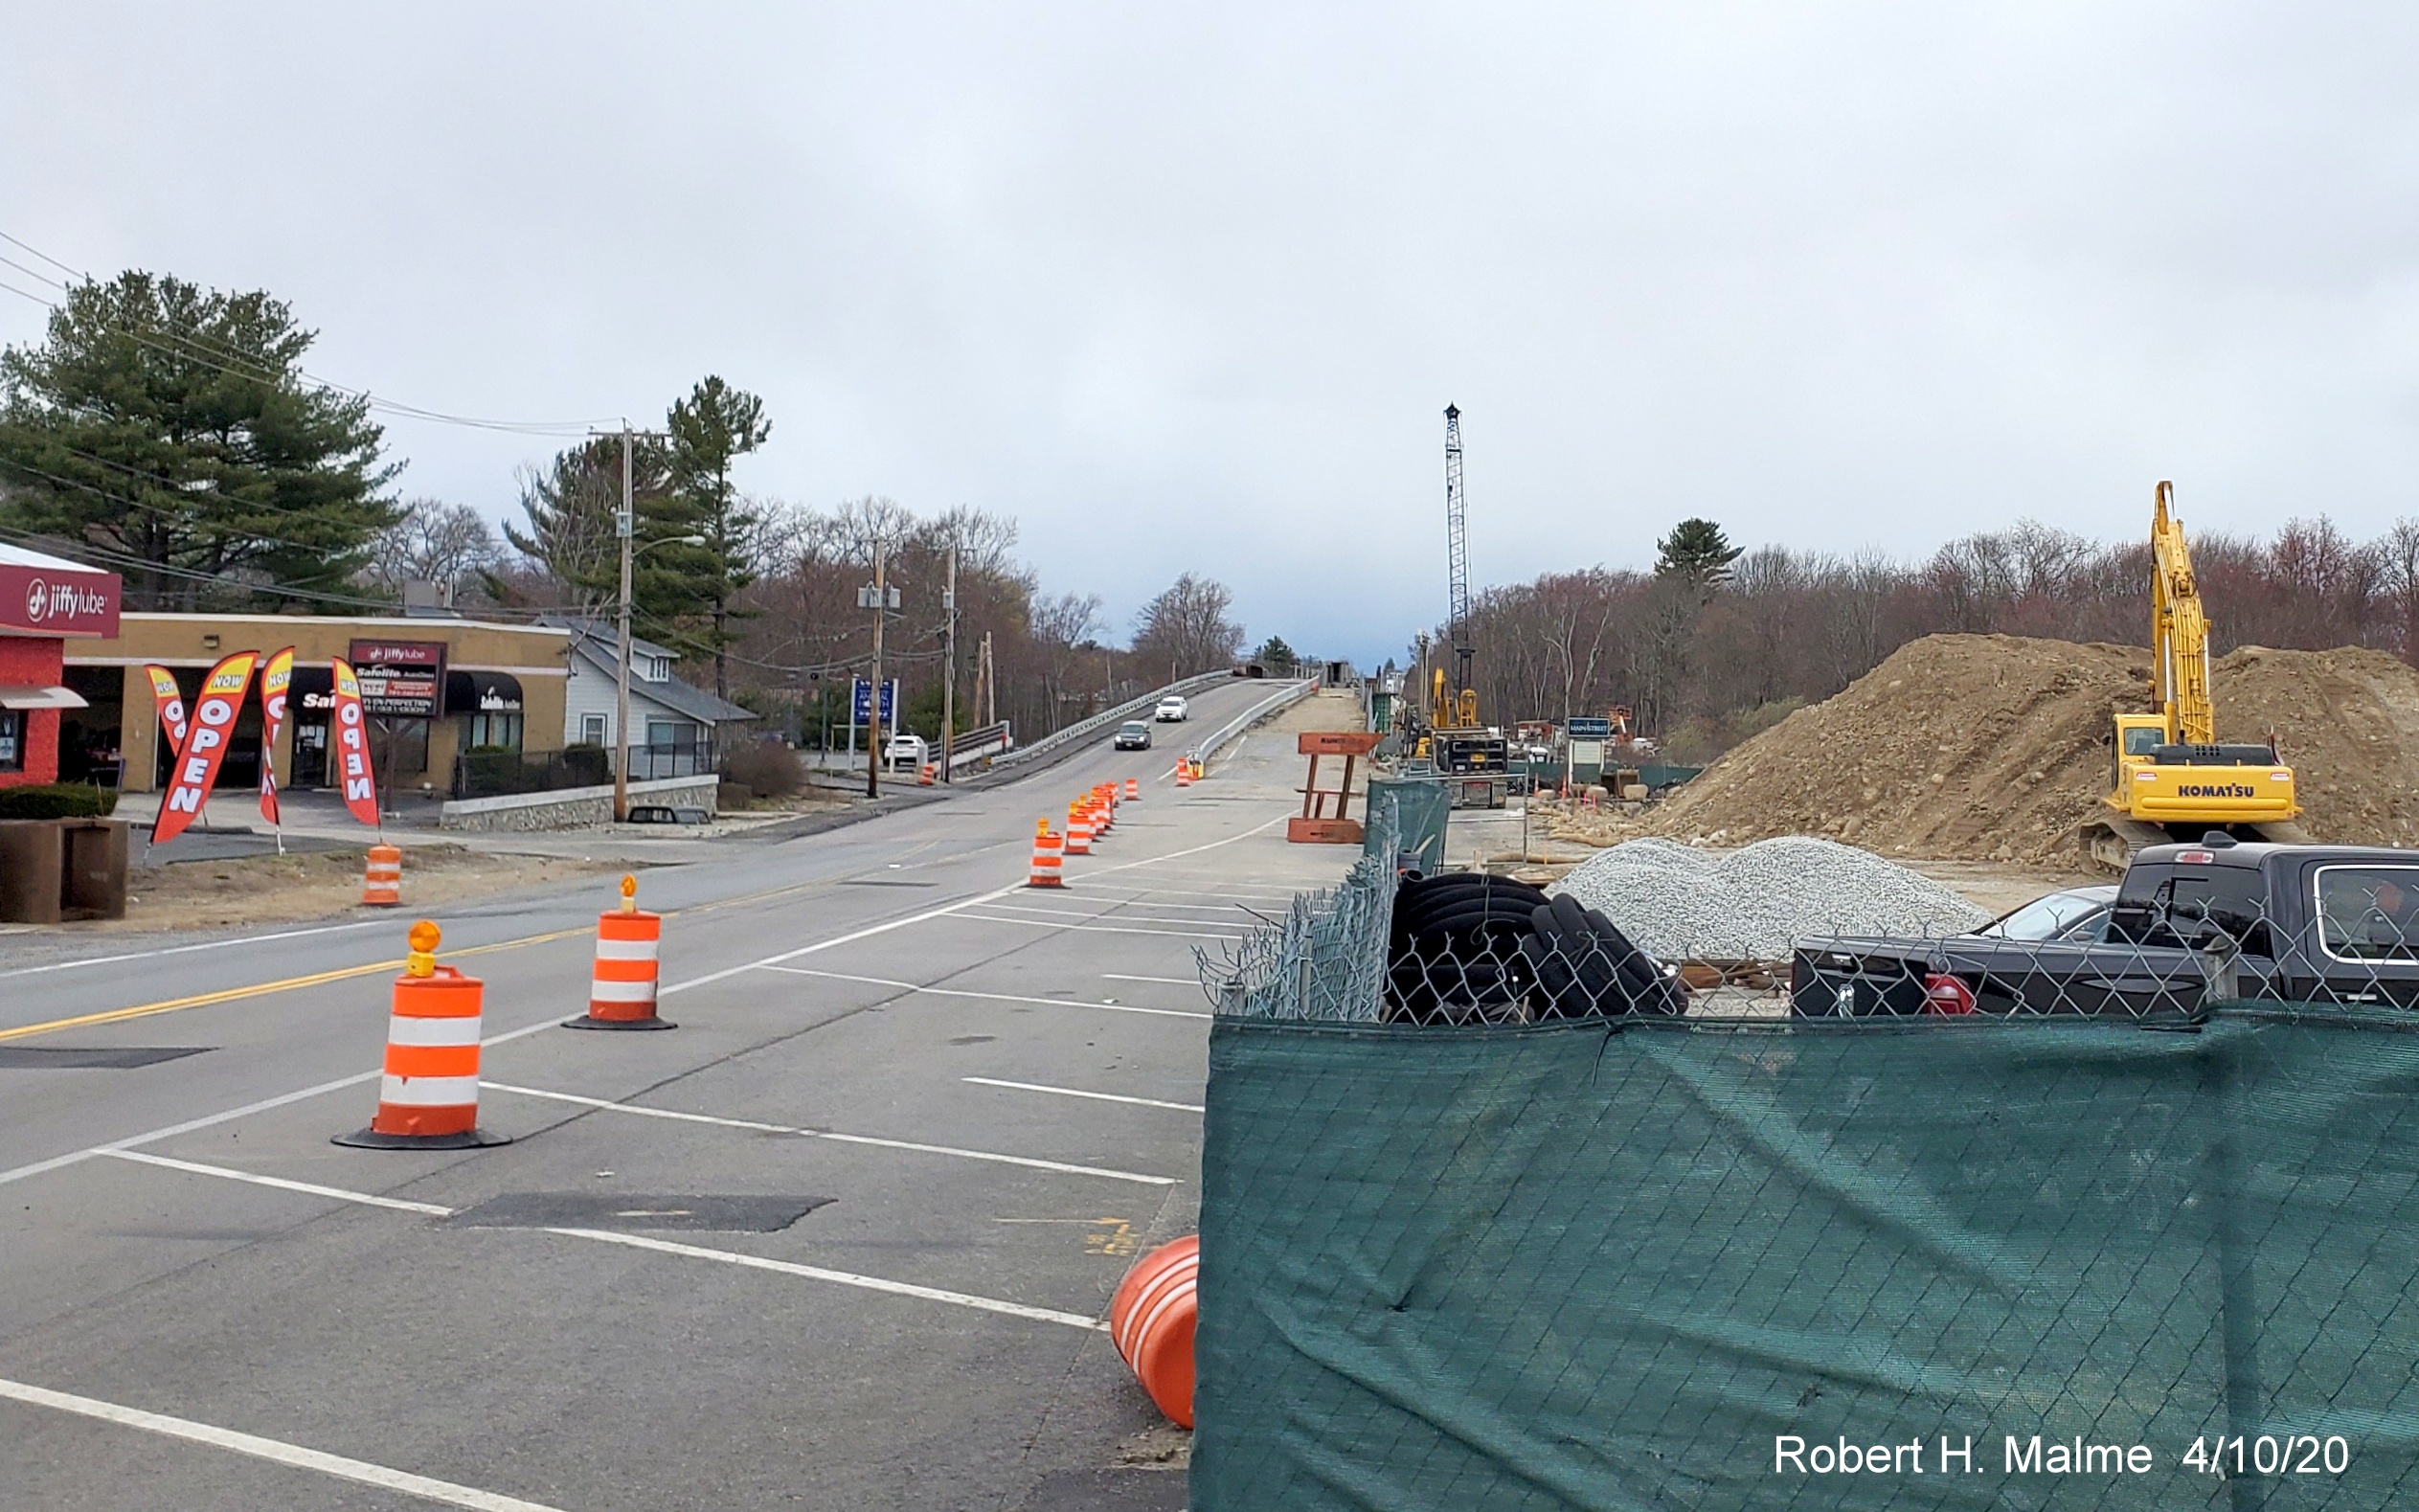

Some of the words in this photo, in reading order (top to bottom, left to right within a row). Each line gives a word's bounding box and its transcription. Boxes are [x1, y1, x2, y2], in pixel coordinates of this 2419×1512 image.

[212, 675, 243, 688] NOW
[169, 699, 232, 814] OPEN
[2179, 783, 2254, 798] KOMATSU
